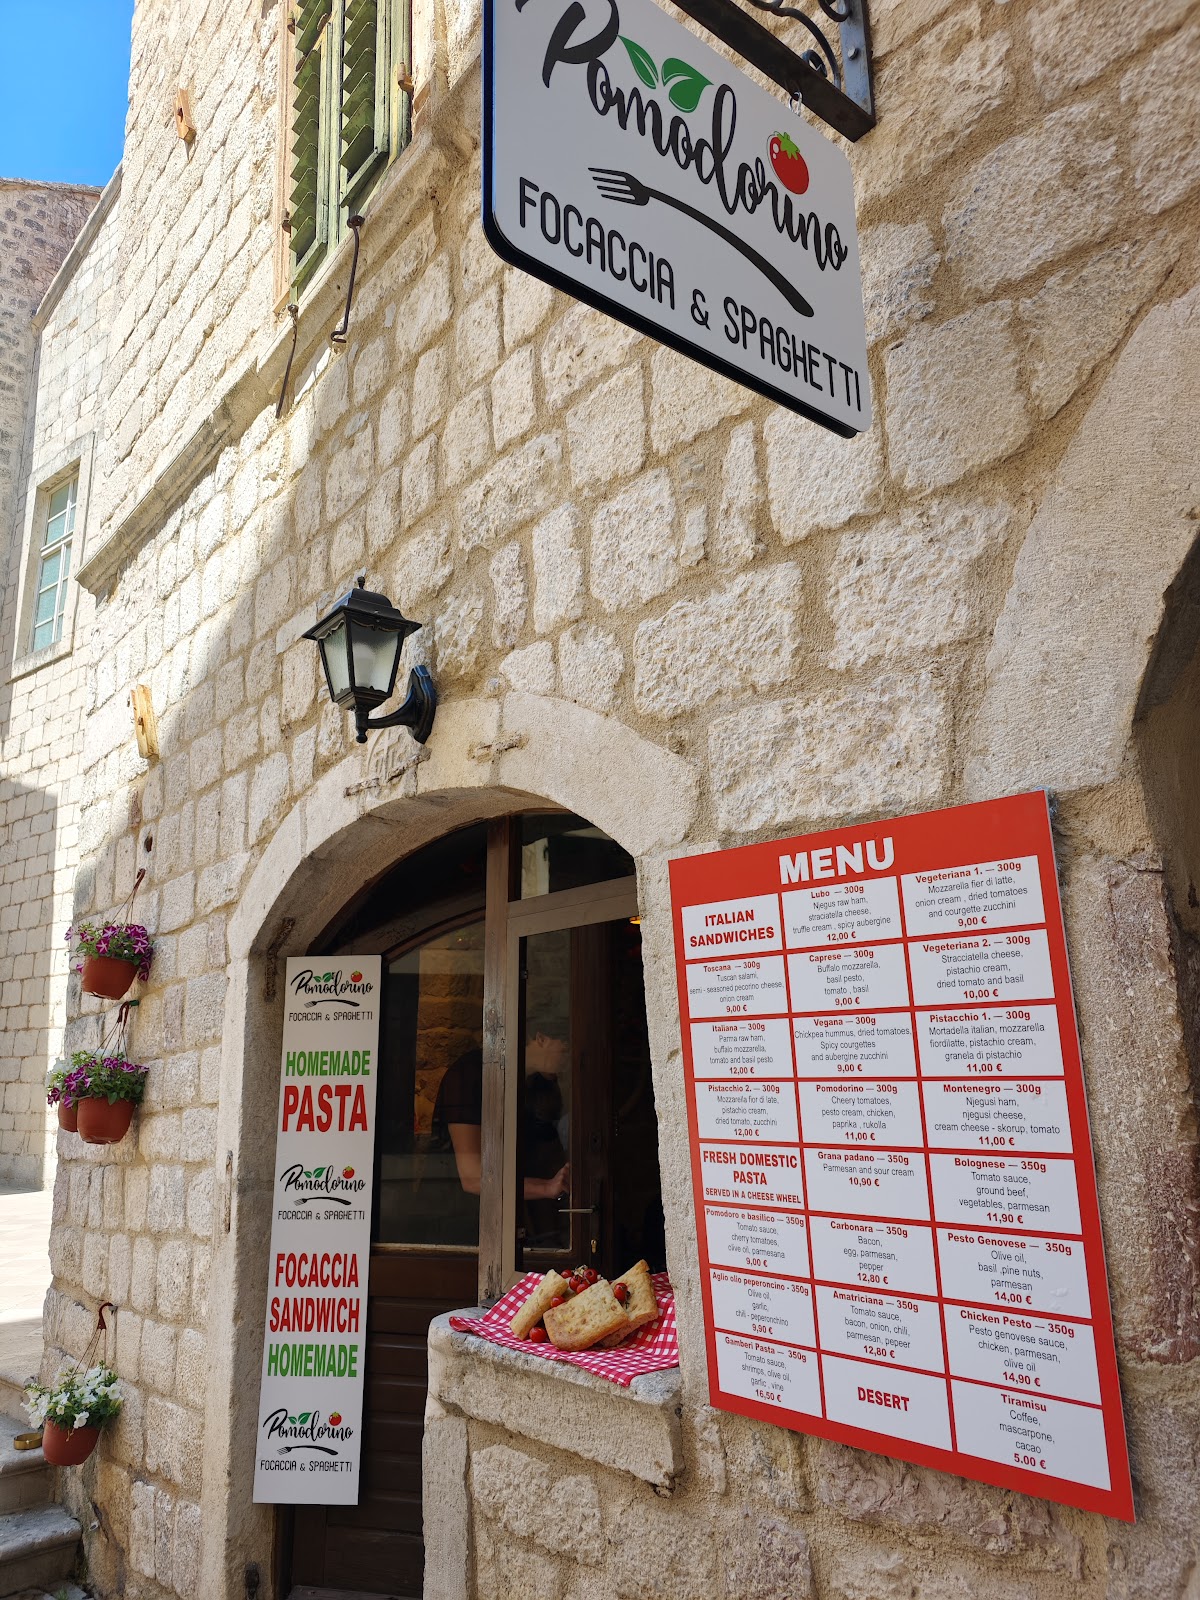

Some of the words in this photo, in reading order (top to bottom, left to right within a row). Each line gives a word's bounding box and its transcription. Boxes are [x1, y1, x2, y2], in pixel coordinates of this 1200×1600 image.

[515, 0, 848, 271] Pomodorino
[518, 177, 675, 310] FOCACCIA
[690, 289, 711, 330] &
[723, 296, 862, 412] SPAGHETTI
[779, 837, 895, 885] MENU
[915, 870, 972, 884] Vegeteriana
[973, 867, 983, 876] 1.
[997, 862, 1022, 872] 300g
[810, 890, 830, 899] Lubo
[844, 885, 864, 895] 300g
[704, 909, 755, 927] ITALIAN
[957, 916, 979, 928] 9,00
[980, 915, 988, 924] €
[689, 926, 775, 948] SANDWICHES
[826, 931, 849, 942] 12,00
[850, 930, 857, 939] €
[922, 941, 980, 954] Vegeteriana
[982, 938, 991, 948] 2.
[1005, 935, 1031, 946] 300g
[809, 953, 842, 964] Caprese
[853, 949, 874, 959] 300g
[941, 951, 989, 964] Stracciatella
[703, 964, 732, 973] Toscana
[743, 960, 761, 970] 300g
[946, 965, 981, 977] pistachio
[290, 970, 373, 996] Pomodorino
[936, 979, 956, 989] dried
[957, 977, 986, 987] tomato
[987, 975, 1003, 985] and
[963, 989, 990, 1000] 10,00
[992, 988, 999, 997] €
[834, 997, 853, 1007] 9,00
[854, 996, 860, 1005] €
[288, 1012, 322, 1022] FOCACCIA
[333, 1011, 373, 1021] SPAGHETTI
[813, 1018, 844, 1028] Vegana
[855, 1016, 876, 1026] 300g
[929, 1012, 979, 1023] Pistacchio
[981, 1012, 991, 1021] 1.
[1005, 1010, 1031, 1021] 300g
[712, 1024, 738, 1032] Italiana
[747, 1022, 766, 1032] 300g
[928, 1025, 970, 1036] Mortadella
[999, 1022, 1045, 1033] mozzarella
[285, 1050, 371, 1076] HOMEMADE
[836, 1063, 855, 1074] 9,00
[857, 1063, 863, 1072] €
[966, 1063, 993, 1074] 11,00
[996, 1063, 1003, 1072] €
[708, 1084, 744, 1092] Pistacchio
[744, 1084, 752, 1092] 2.
[762, 1084, 780, 1094] 300g
[816, 1084, 864, 1093] Pomodorino
[876, 1084, 898, 1095] 300g
[943, 1084, 1001, 1095] Montenegro
[1016, 1083, 1042, 1096] 300g
[282, 1084, 368, 1132] PASTA
[962, 1110, 991, 1121] njegusi
[844, 1131, 868, 1142] 11,00
[869, 1132, 876, 1141] €
[978, 1136, 1006, 1147] 11,00
[1008, 1137, 1015, 1146] €
[703, 1150, 737, 1165] FRESH
[739, 1152, 798, 1169] DOMESTIC
[817, 1151, 842, 1161] Grana
[844, 1153, 875, 1163] padano
[887, 1154, 909, 1166] 350g
[954, 1157, 1006, 1170] Bolognese
[1020, 1160, 1047, 1173] 350g
[280, 1163, 366, 1193] Pomodorino
[733, 1170, 768, 1186] PASTA
[848, 1176, 872, 1187] 10,90
[874, 1178, 880, 1187] €
[970, 1171, 1001, 1182] Tomato
[705, 1187, 731, 1197] SERVED
[732, 1190, 740, 1198] IN
[740, 1190, 746, 1199] A
[747, 1191, 775, 1202] CHEESE
[775, 1193, 802, 1204] WHEEL
[976, 1186, 1005, 1197] ground
[1007, 1202, 1050, 1212] parmesan
[278, 1210, 312, 1220] FOCACCIA
[324, 1210, 365, 1220] SPAGHETTI
[706, 1208, 740, 1219] Pomodoro
[747, 1212, 775, 1223] basilico
[785, 1216, 805, 1228] 350g
[986, 1212, 1014, 1224] 11,90
[1016, 1214, 1024, 1224] €
[830, 1220, 874, 1233] Carbonara
[886, 1226, 908, 1239] 350g
[947, 1232, 975, 1244] Pesto
[977, 1235, 1027, 1249] Genovese
[1045, 1242, 1072, 1256] 350g
[275, 1252, 359, 1288] FOCACCIA
[712, 1271, 729, 1282] Aglio
[729, 1274, 742, 1284] olio
[743, 1278, 786, 1291] peperoncino
[791, 1284, 809, 1297] 350g
[857, 1272, 881, 1284] 12,80
[882, 1275, 889, 1285] €
[990, 1279, 1033, 1291] parmesan
[833, 1290, 884, 1306] Amatriciana
[896, 1299, 919, 1313] 350g
[994, 1291, 1023, 1304] 14,00
[1025, 1295, 1032, 1305] €
[269, 1297, 360, 1333] SANDWICH
[751, 1323, 767, 1334] 9,90
[768, 1326, 773, 1335] €
[960, 1309, 1000, 1324] Chicken
[1002, 1315, 1032, 1329] Pesto
[1047, 1322, 1075, 1339] 350g
[968, 1324, 993, 1337] Pesto
[994, 1330, 1036, 1344] genovese
[724, 1336, 754, 1350] Gamberi
[754, 1342, 776, 1355] Pasta
[787, 1349, 807, 1364] 350g
[863, 1344, 887, 1357] 12,80
[889, 1349, 896, 1359] €
[267, 1343, 358, 1378] HOMEMADE
[1003, 1358, 1024, 1370] olive
[1026, 1362, 1036, 1372] oil
[1002, 1371, 1031, 1385] 14,90
[1034, 1377, 1041, 1387] €
[755, 1388, 775, 1401] 16,50
[776, 1394, 782, 1403] €
[857, 1386, 910, 1412] DESERT
[1000, 1393, 1047, 1412] Tiramisu
[262, 1408, 353, 1442] Pomodorino
[1015, 1440, 1042, 1454] cacao
[260, 1459, 297, 1471] FOCACCIA
[308, 1460, 352, 1473] SPAGHETTI
[1014, 1452, 1036, 1467] 5.00
[1039, 1459, 1047, 1470] €
